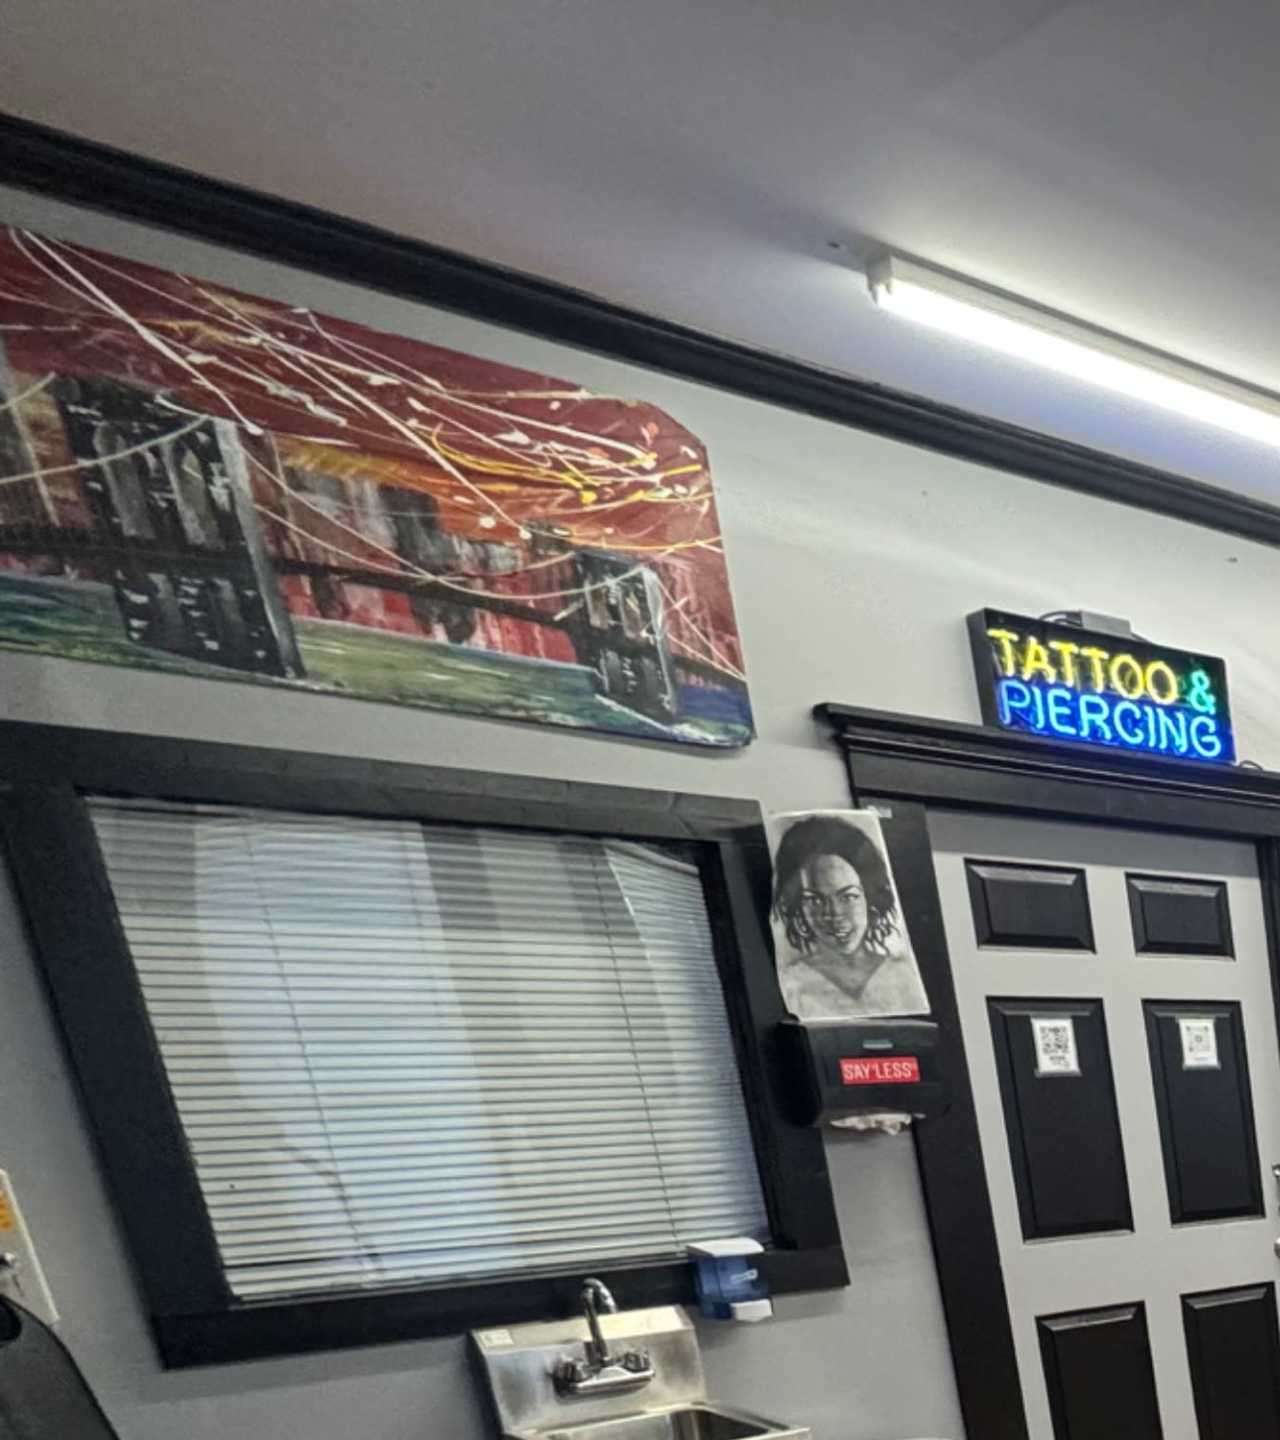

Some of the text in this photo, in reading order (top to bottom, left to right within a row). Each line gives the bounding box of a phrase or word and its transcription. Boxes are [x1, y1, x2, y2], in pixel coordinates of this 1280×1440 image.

[987, 628, 1216, 714] TATTOO &
[999, 679, 1222, 757] PIERCING
[843, 1063, 870, 1081] SAY
